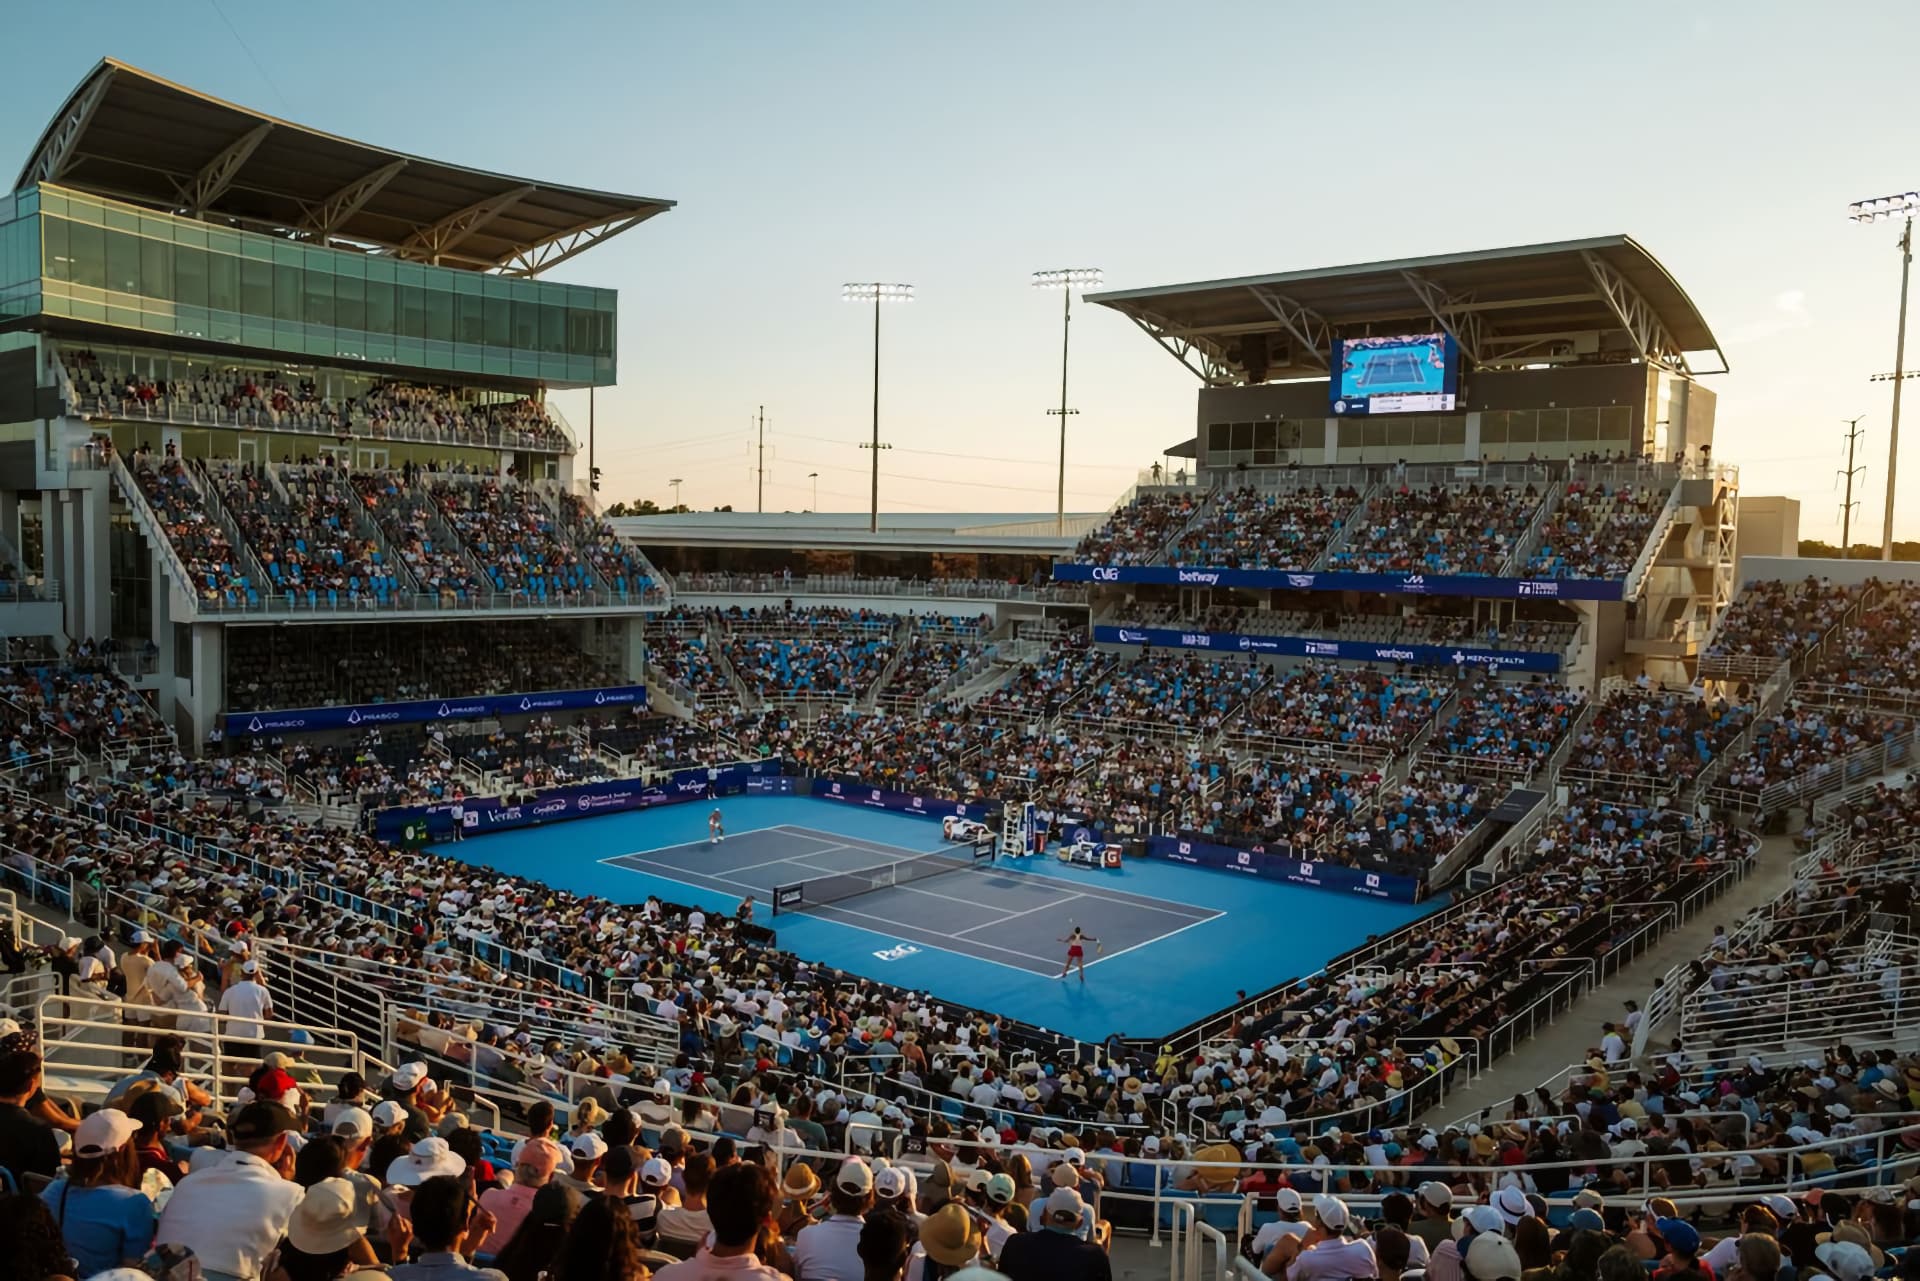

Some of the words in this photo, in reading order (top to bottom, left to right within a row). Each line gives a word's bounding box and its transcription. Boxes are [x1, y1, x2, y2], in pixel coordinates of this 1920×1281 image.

[1179, 570, 1219, 585] betway
[1376, 648, 1414, 661] verizon
[1107, 851, 1117, 863] G
